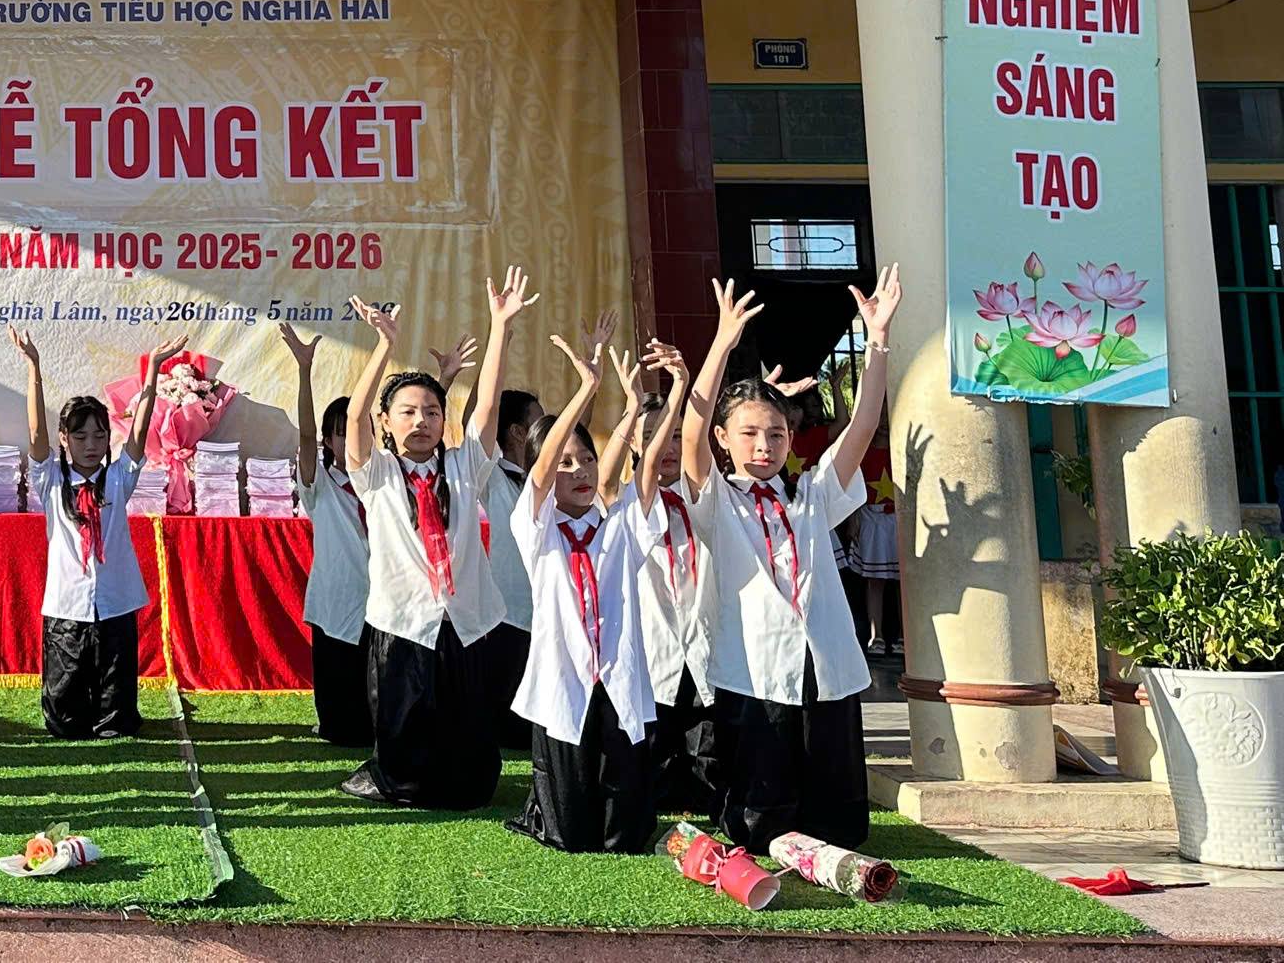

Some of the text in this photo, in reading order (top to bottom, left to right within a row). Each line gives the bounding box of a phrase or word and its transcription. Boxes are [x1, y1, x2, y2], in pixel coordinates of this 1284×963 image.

[174, 0, 234, 27] HỌC
[773, 55, 789, 64] 101
[994, 53, 1116, 122] SÁNG
[63, 76, 259, 181] TỔNG
[286, 80, 424, 180] KẾT
[1015, 150, 1099, 220] TẠO
[0, 226, 79, 269] NĂM
[94, 232, 163, 278] HỌC
[292, 232, 383, 270] 2026
[52, 301, 107, 324] Lâm,
[285, 302, 333, 321] năm
[341, 301, 397, 321] 26
